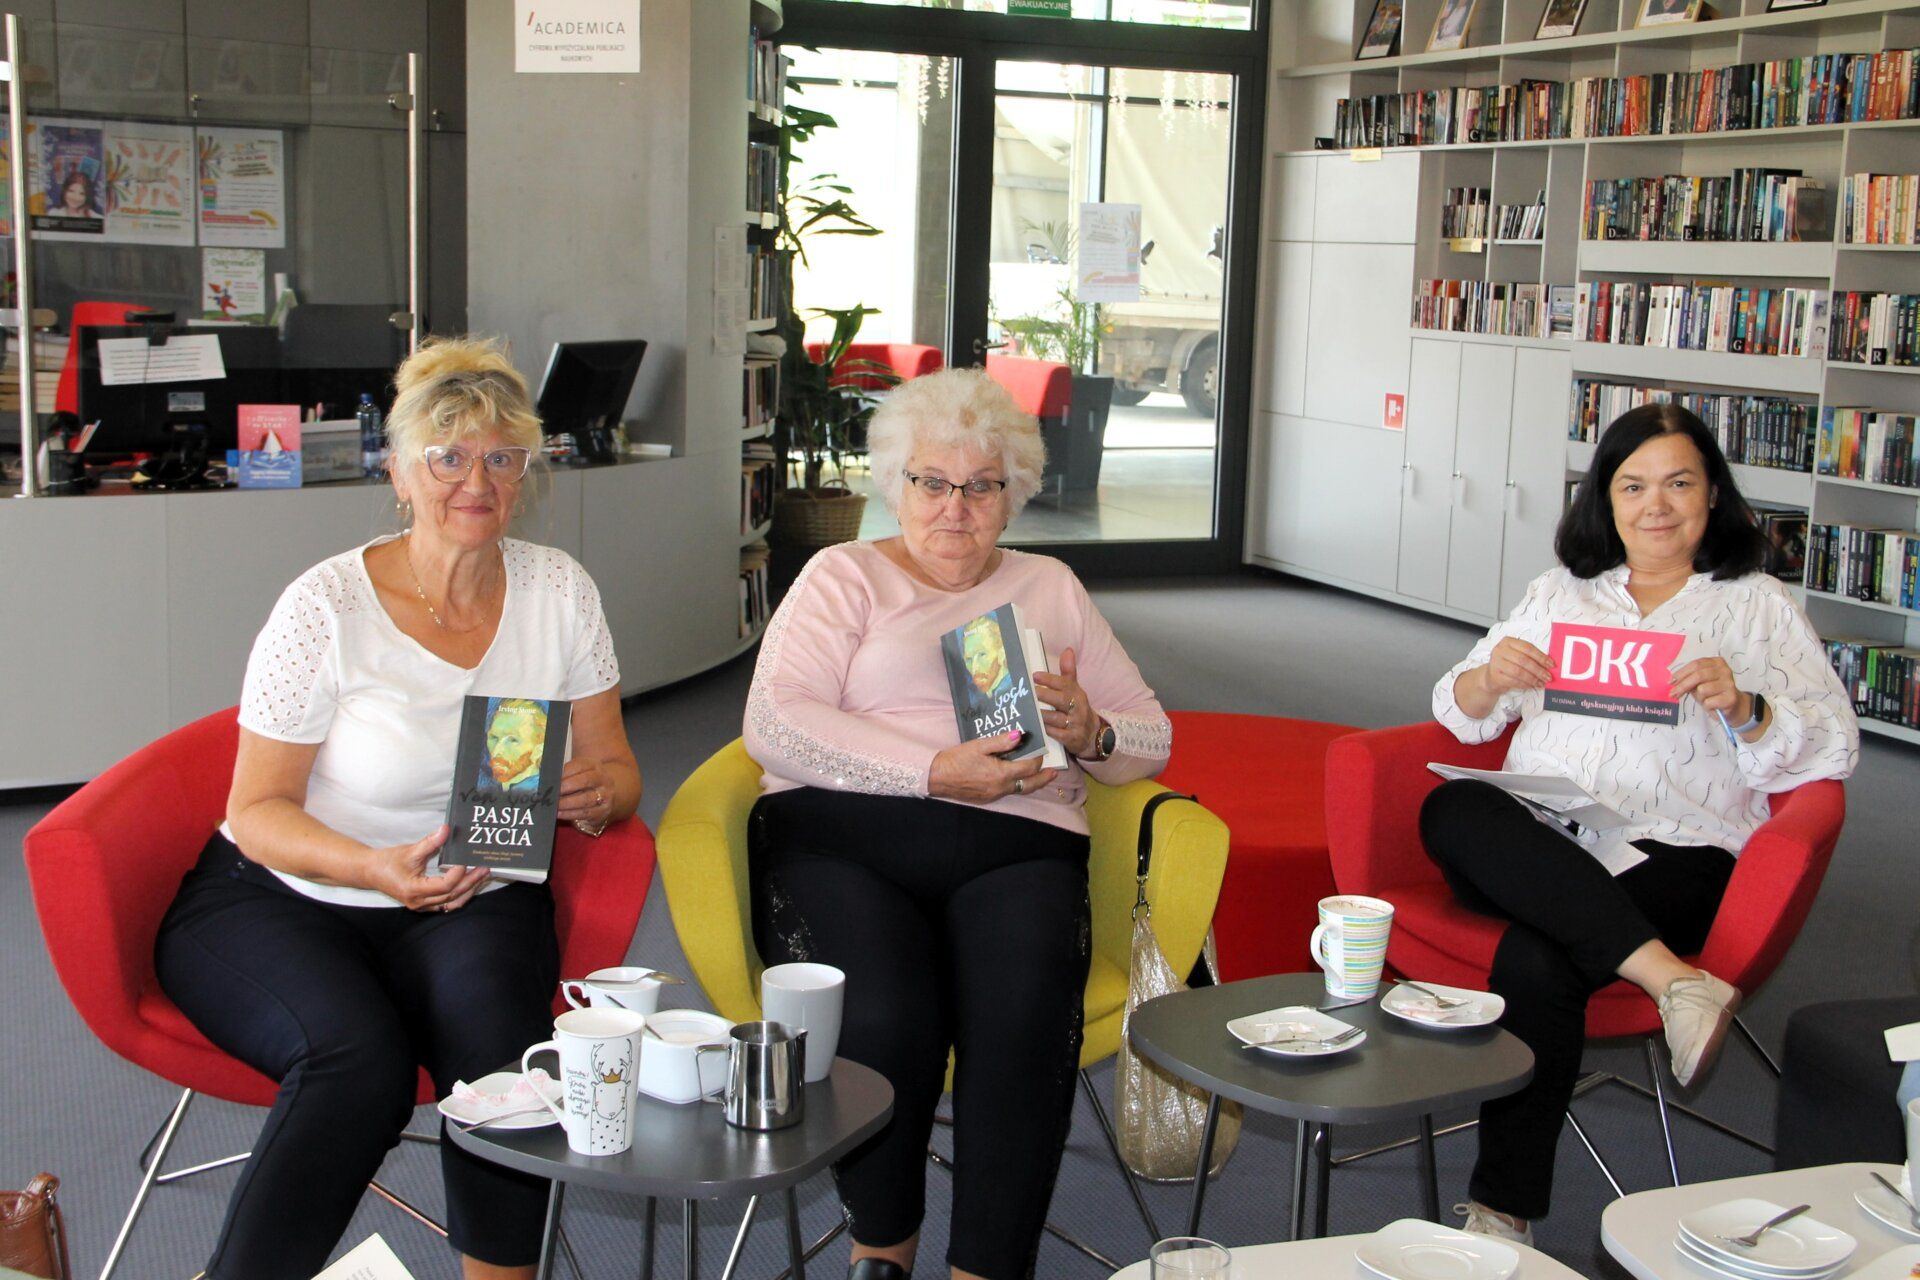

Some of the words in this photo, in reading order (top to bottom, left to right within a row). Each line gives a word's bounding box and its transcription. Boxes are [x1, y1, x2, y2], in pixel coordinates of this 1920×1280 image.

[1009, 0, 1069, 11] EWAKUACYJNE
[534, 21, 626, 35] ACADEMICA
[1470, 129, 1479, 141] C
[1608, 227, 1617, 239] D
[1684, 228, 1694, 240] E
[1754, 228, 1762, 240] F
[1733, 339, 1742, 351] G
[1873, 350, 1882, 362] R
[1861, 587, 1870, 600] S
[1560, 634, 1653, 688] DKK
[1580, 699, 1625, 713] dyskusyjny
[1625, 703, 1644, 714] klub
[973, 703, 1022, 735] PASJA
[471, 805, 535, 828] PASJA
[467, 823, 533, 847] ŻYCIA
